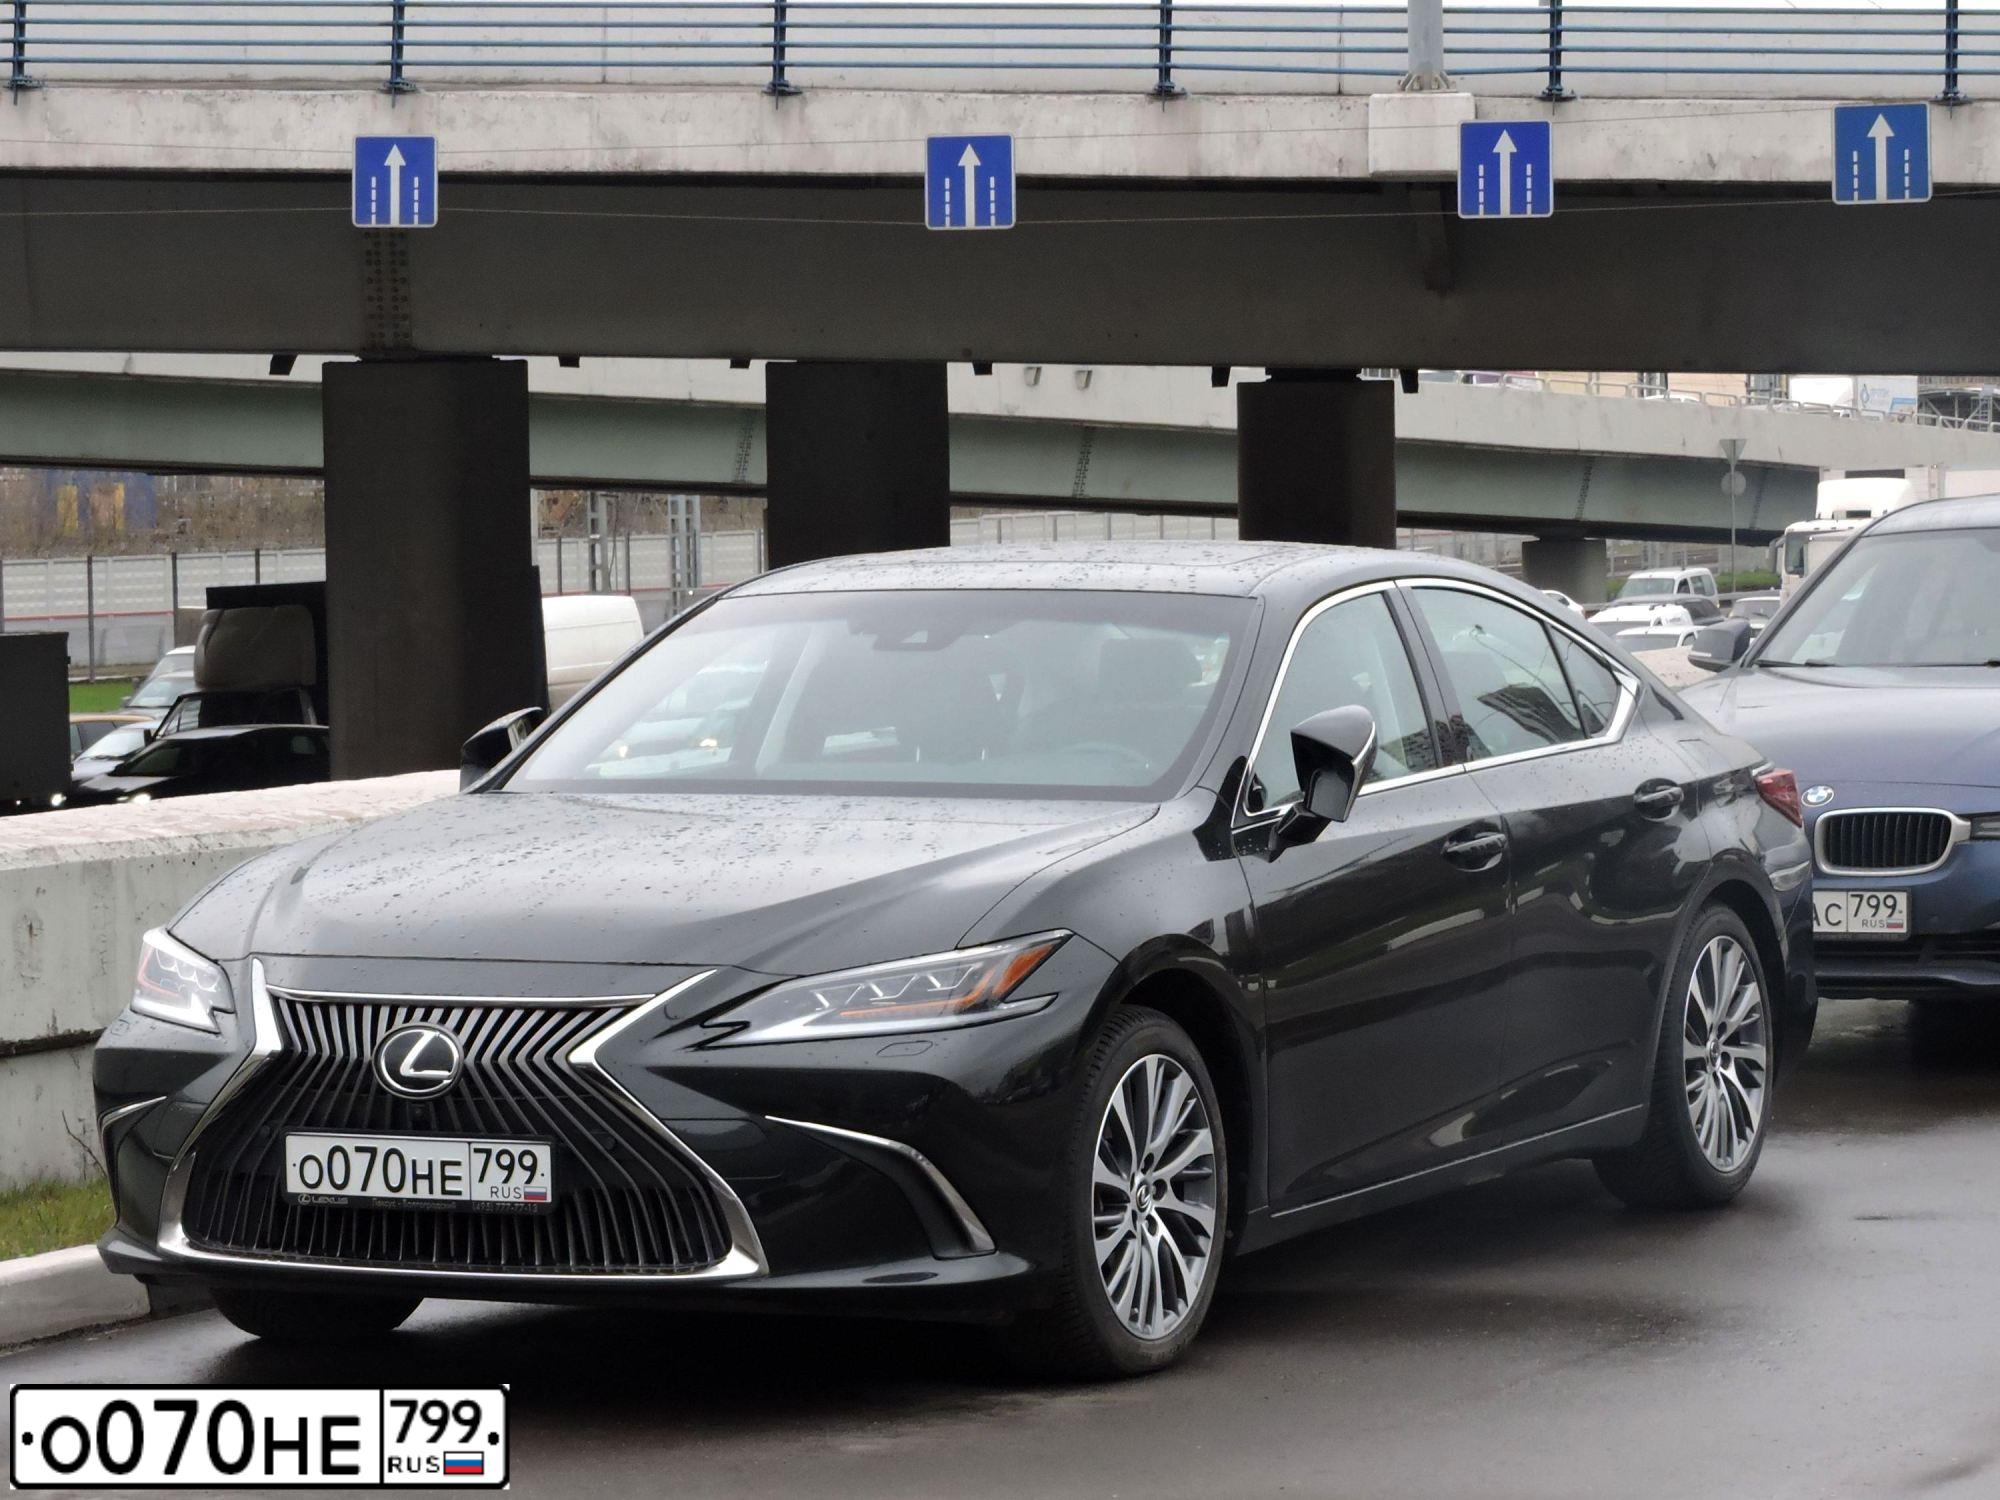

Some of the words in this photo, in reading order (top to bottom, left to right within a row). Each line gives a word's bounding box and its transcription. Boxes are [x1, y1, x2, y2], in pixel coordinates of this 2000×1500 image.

[1850, 894, 1897, 918] 799
[1861, 919, 1885, 929] RUS
[299, 1145, 462, 1196] O070HE
[473, 1147, 538, 1185] 799
[490, 1186, 522, 1199] RUS
